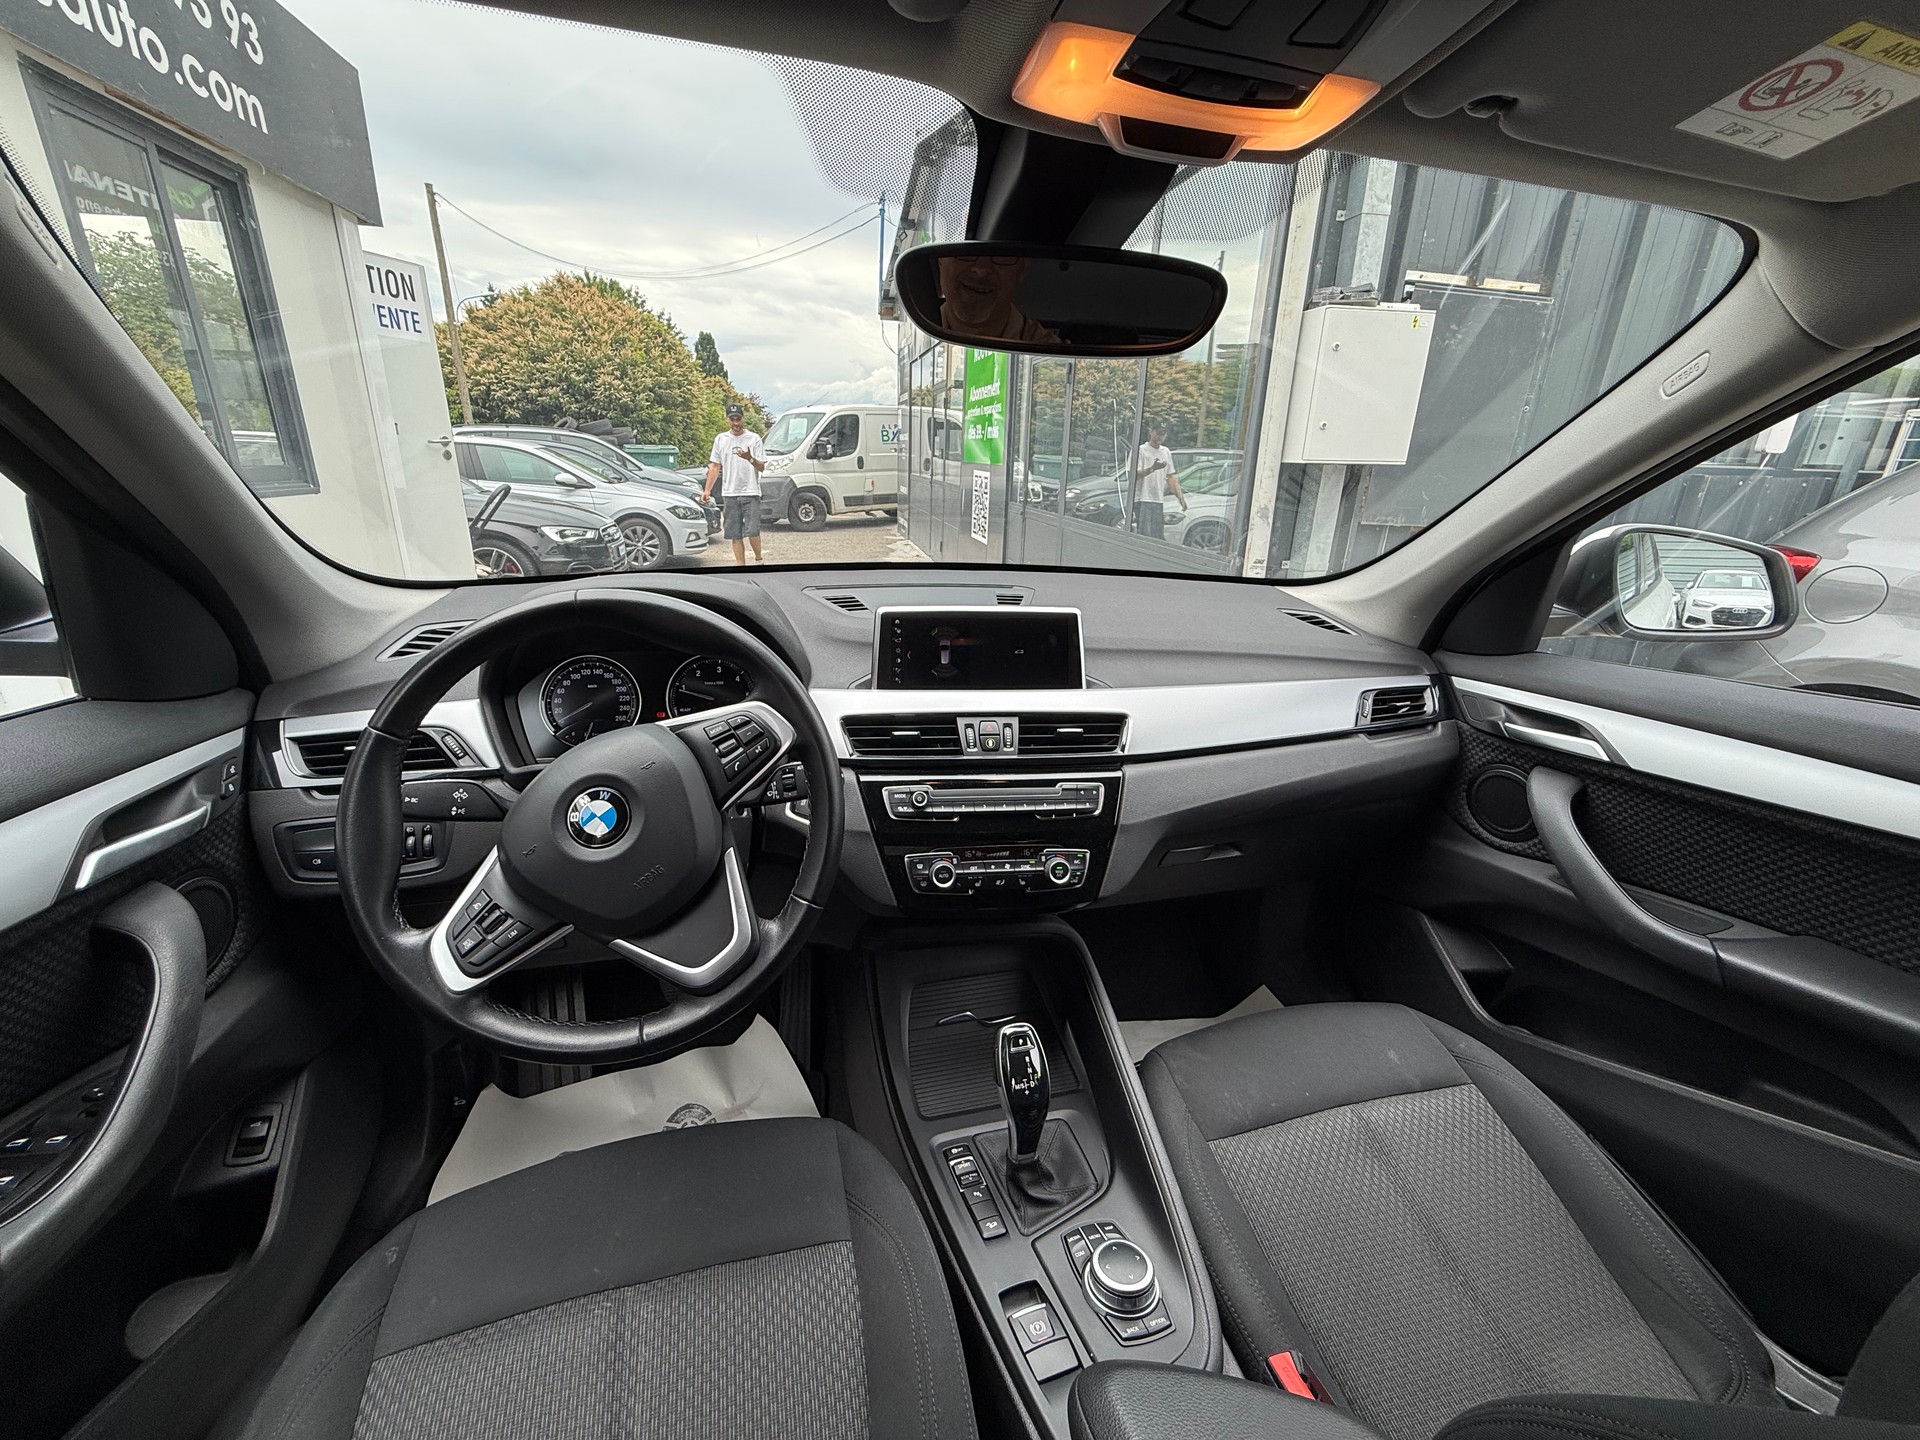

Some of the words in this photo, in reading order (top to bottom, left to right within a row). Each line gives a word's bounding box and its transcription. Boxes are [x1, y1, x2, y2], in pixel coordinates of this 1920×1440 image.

[220, 0, 264, 65] 93
[34, 0, 269, 135] auto.com
[365, 264, 416, 302] TION
[1670, 362, 1700, 389] AIRBAG
[570, 790, 612, 822] BMW
[633, 865, 665, 890] AIRBAG
